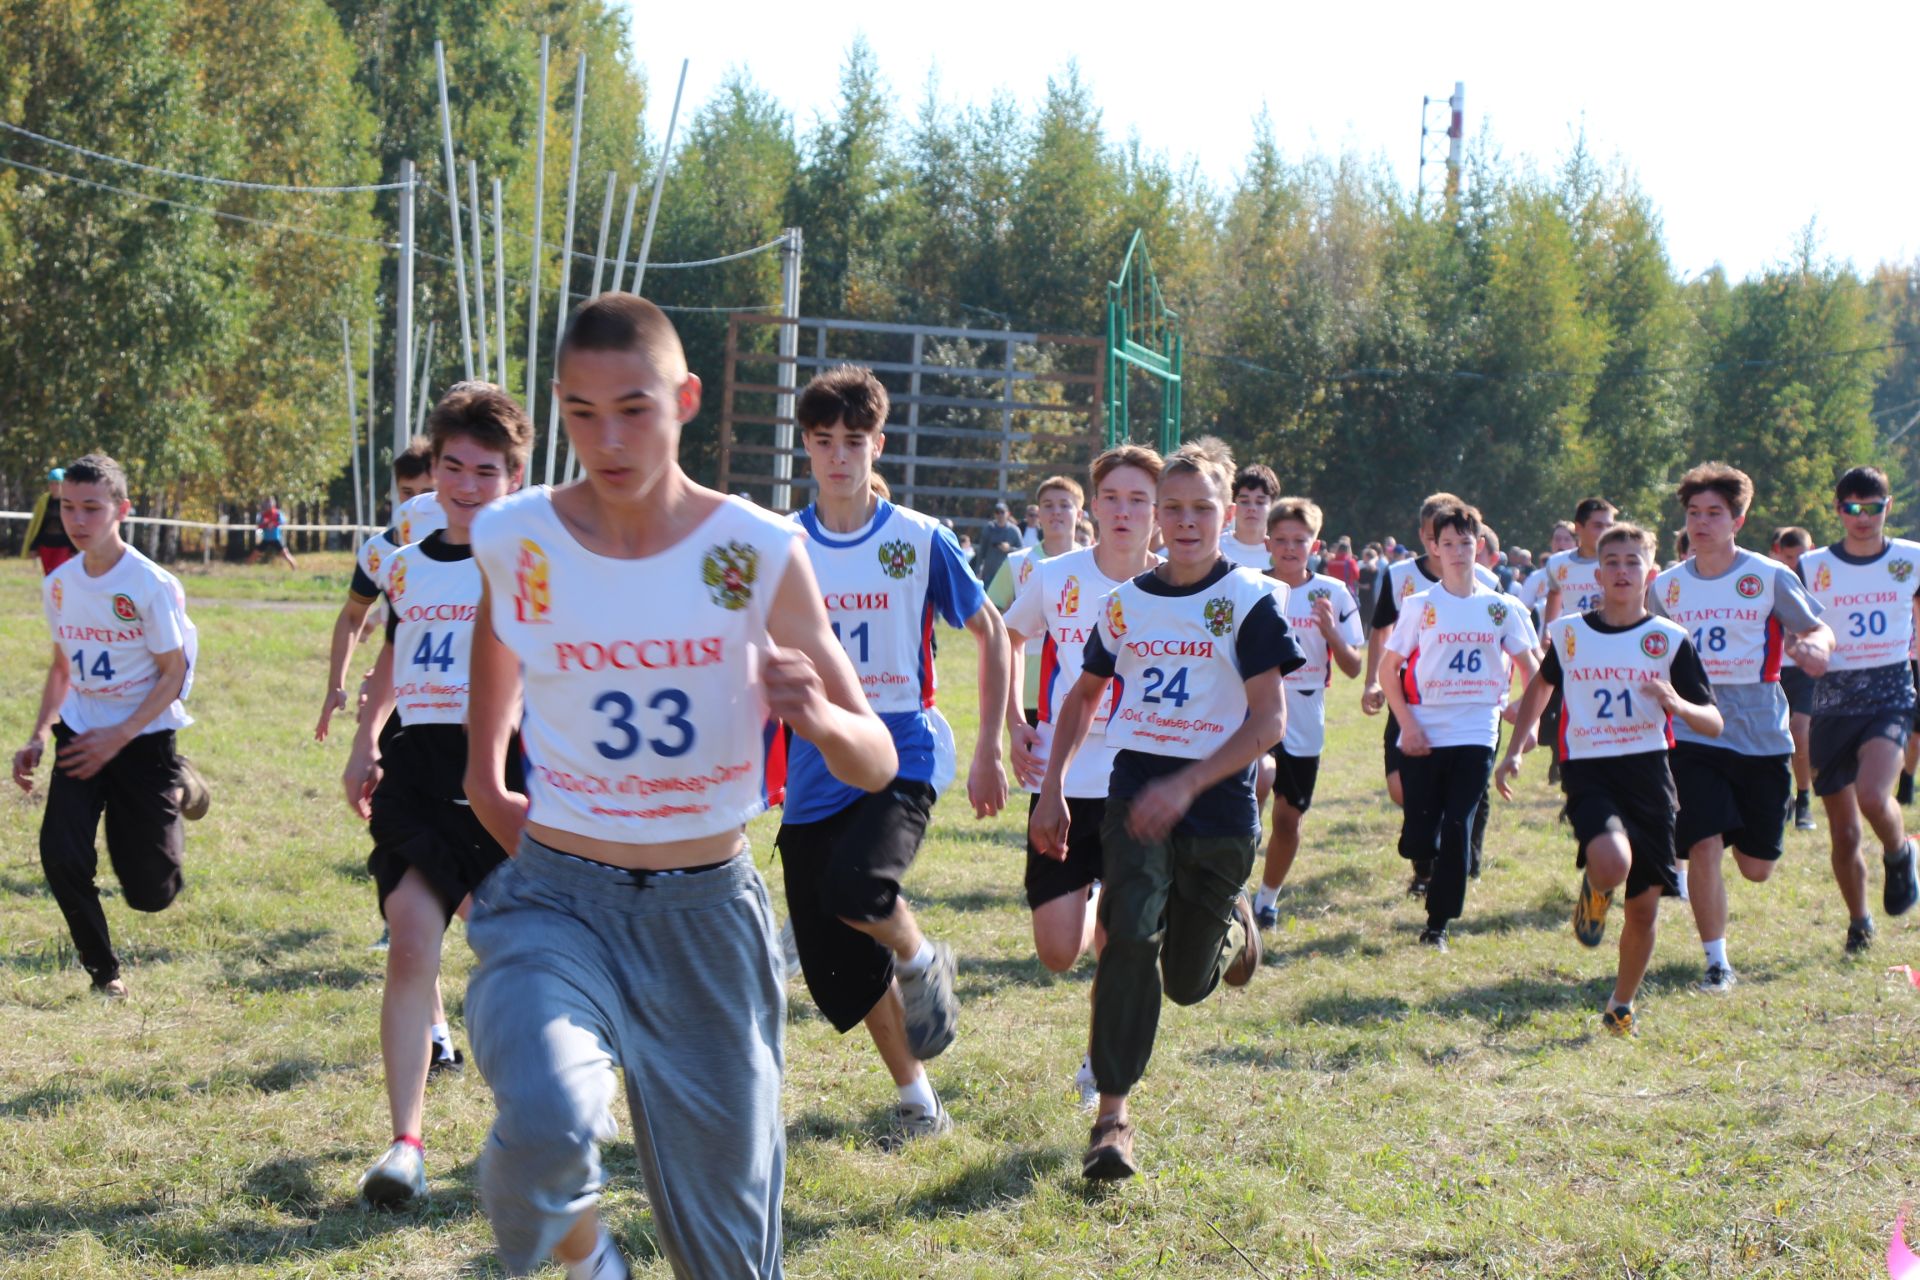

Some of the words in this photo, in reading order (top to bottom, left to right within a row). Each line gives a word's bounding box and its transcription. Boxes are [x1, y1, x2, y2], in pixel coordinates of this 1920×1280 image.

[824, 592, 890, 611] ССИЯ
[1833, 591, 1897, 607] РОССИЯ
[58, 625, 144, 643] АТАРСТАН
[1849, 610, 1887, 638] 30
[413, 631, 455, 673] 44
[1438, 632, 1495, 645] РОССИЯ
[1692, 626, 1726, 654] 18
[72, 649, 116, 682] 14
[553, 636, 725, 672] РОССИЯ
[1448, 648, 1482, 674] 46
[1142, 666, 1190, 708] 24
[1593, 688, 1633, 719] 21
[592, 687, 697, 761] 33
